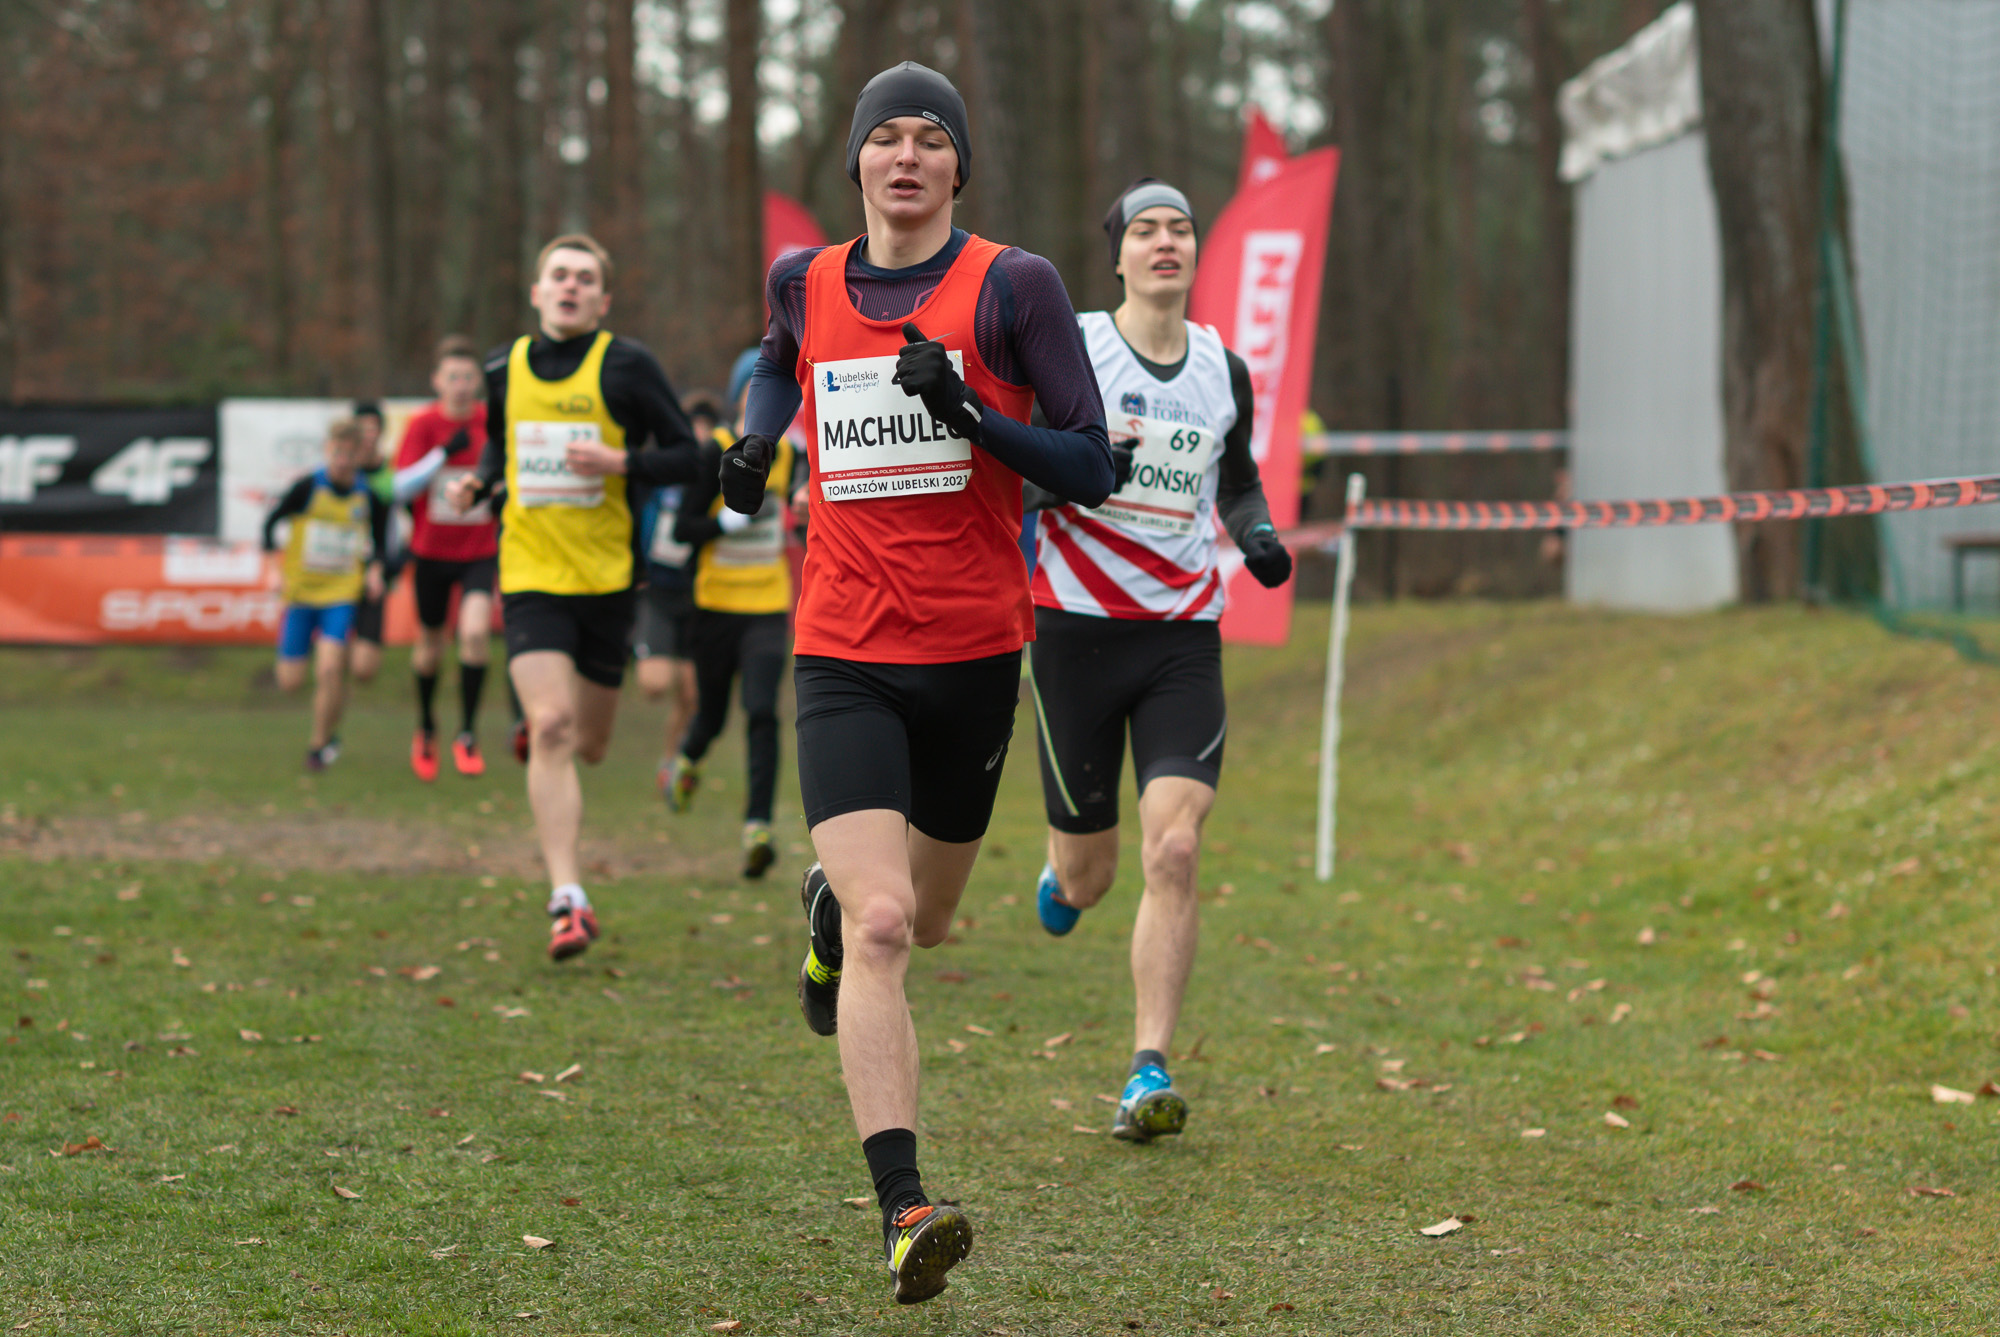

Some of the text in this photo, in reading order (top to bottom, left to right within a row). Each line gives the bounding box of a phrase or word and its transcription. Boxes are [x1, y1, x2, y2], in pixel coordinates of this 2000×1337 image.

[838, 371, 879, 383] lubelskie
[1170, 429, 1200, 453] 69
[89, 435, 214, 505] 4F
[828, 474, 968, 496] TOMASZÓW LUBELSKI 2021
